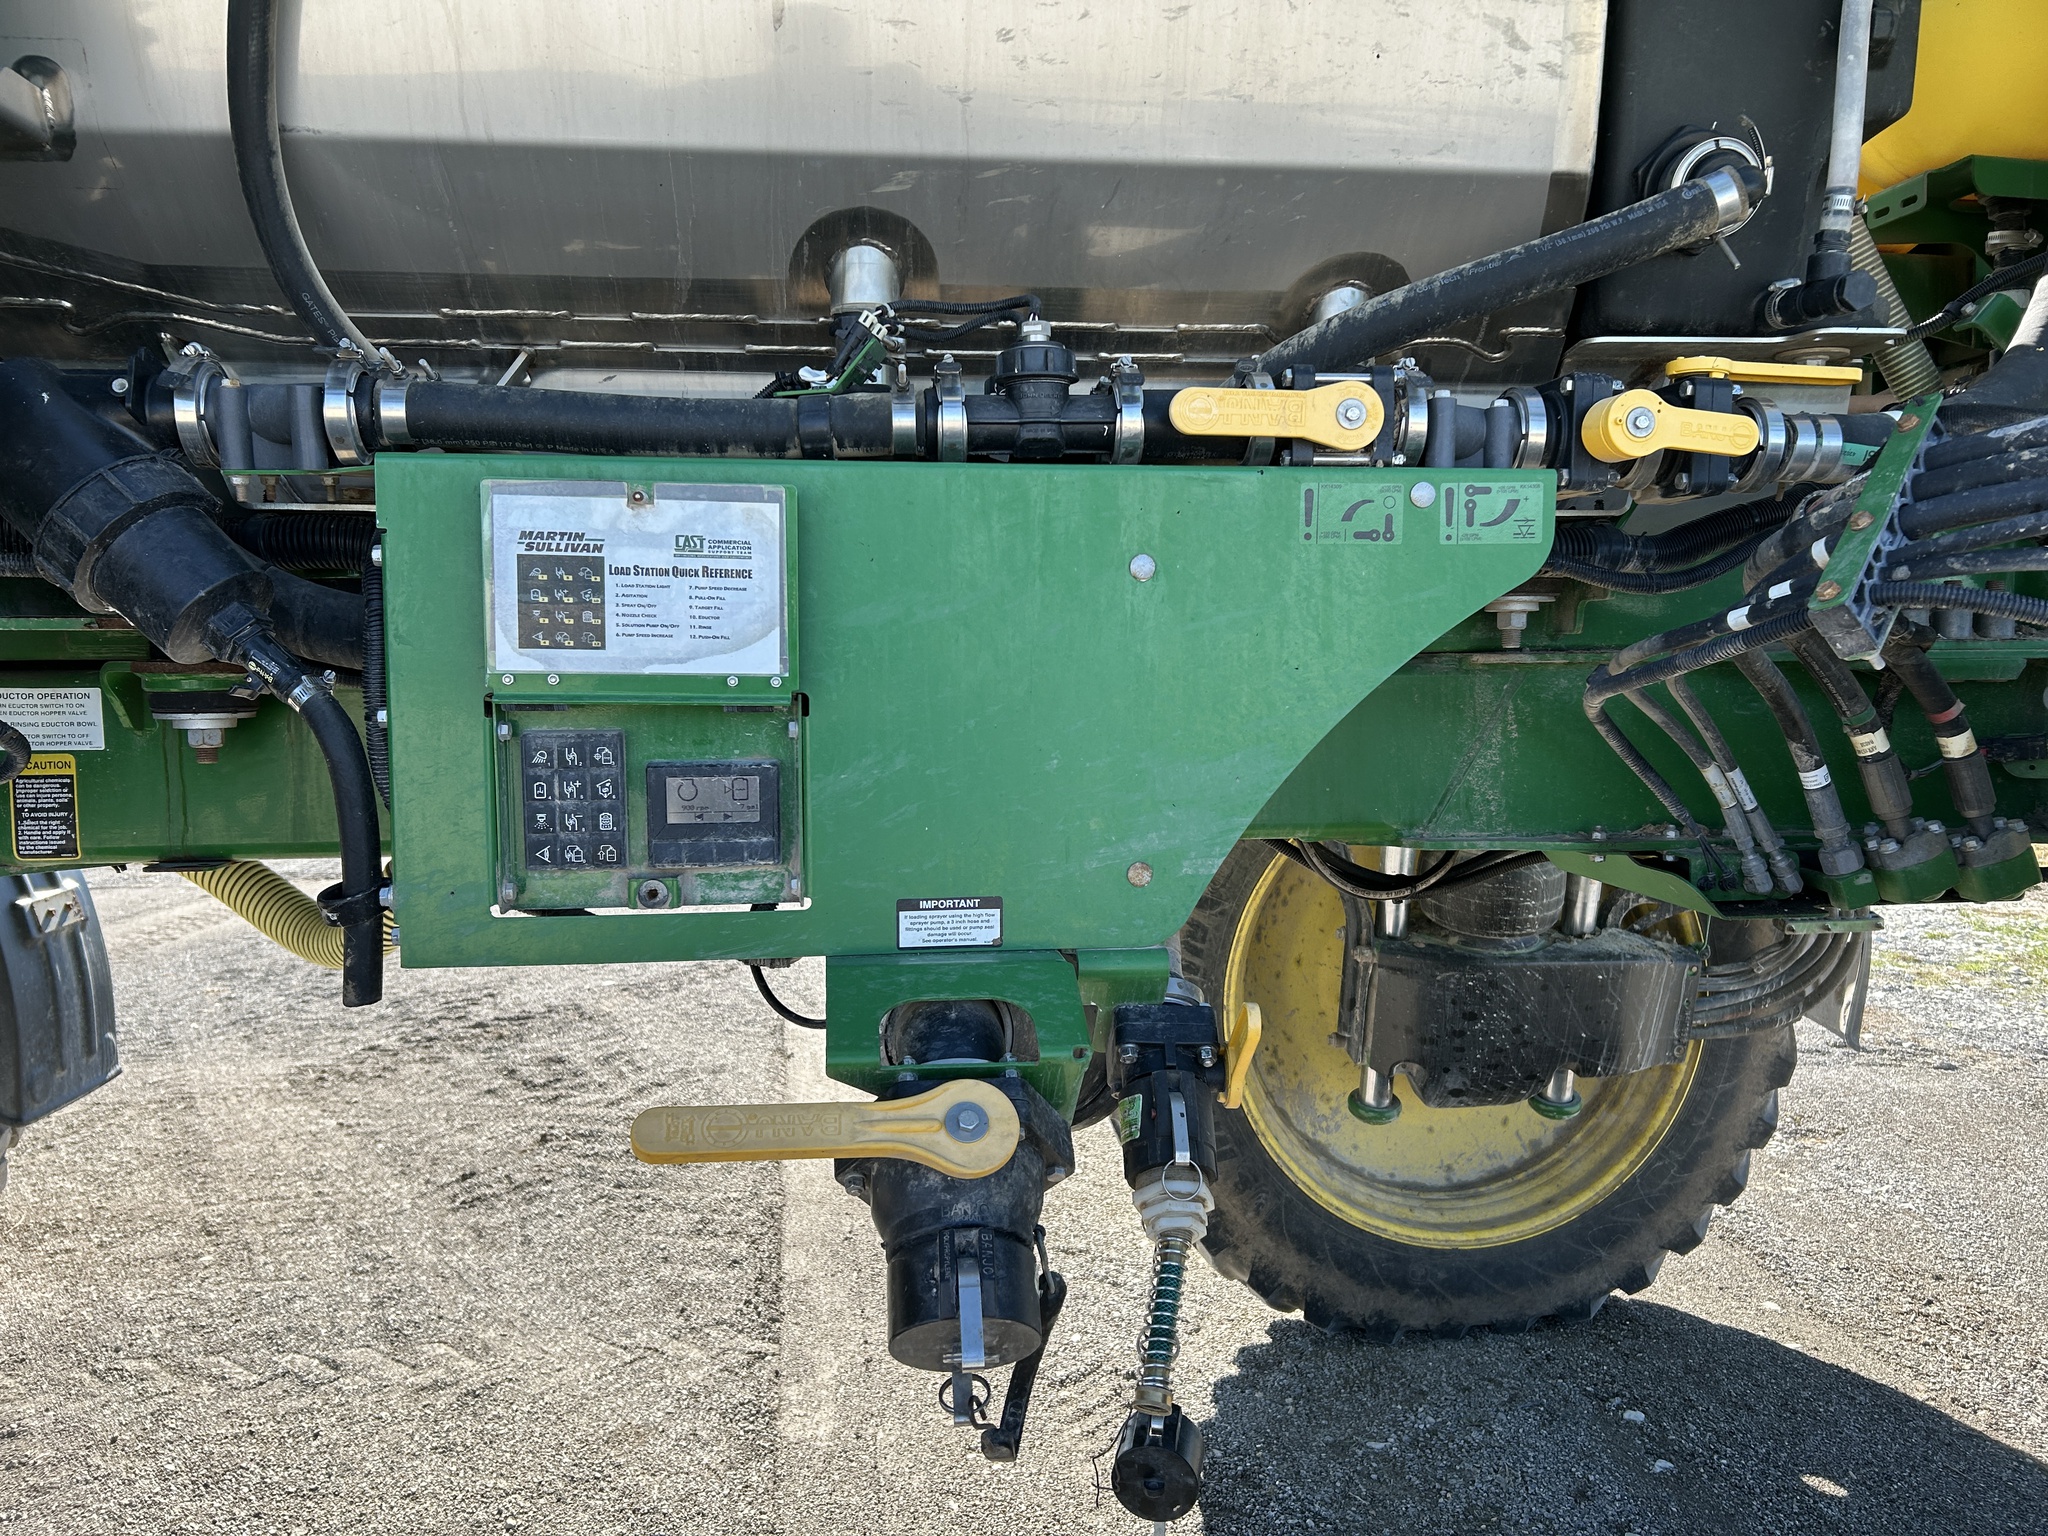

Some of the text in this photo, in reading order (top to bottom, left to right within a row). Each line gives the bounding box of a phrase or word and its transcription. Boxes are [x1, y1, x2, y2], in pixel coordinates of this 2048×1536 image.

[1600, 222, 1611, 231] PSI
[1627, 210, 1647, 221] MADE
[1656, 200, 1669, 210] USA
[1470, 259, 1502, 275] Frontier
[519, 531, 585, 541] MARTIN
[524, 542, 604, 553] SULLIVAN
[609, 564, 752, 579] LOAD STATION QUICK REFERENCE
[26, 761, 72, 770] CAUTION
[920, 899, 980, 909] IMPORTANT
[941, 1204, 989, 1217] BANJO
[982, 1234, 994, 1275] BANJO
